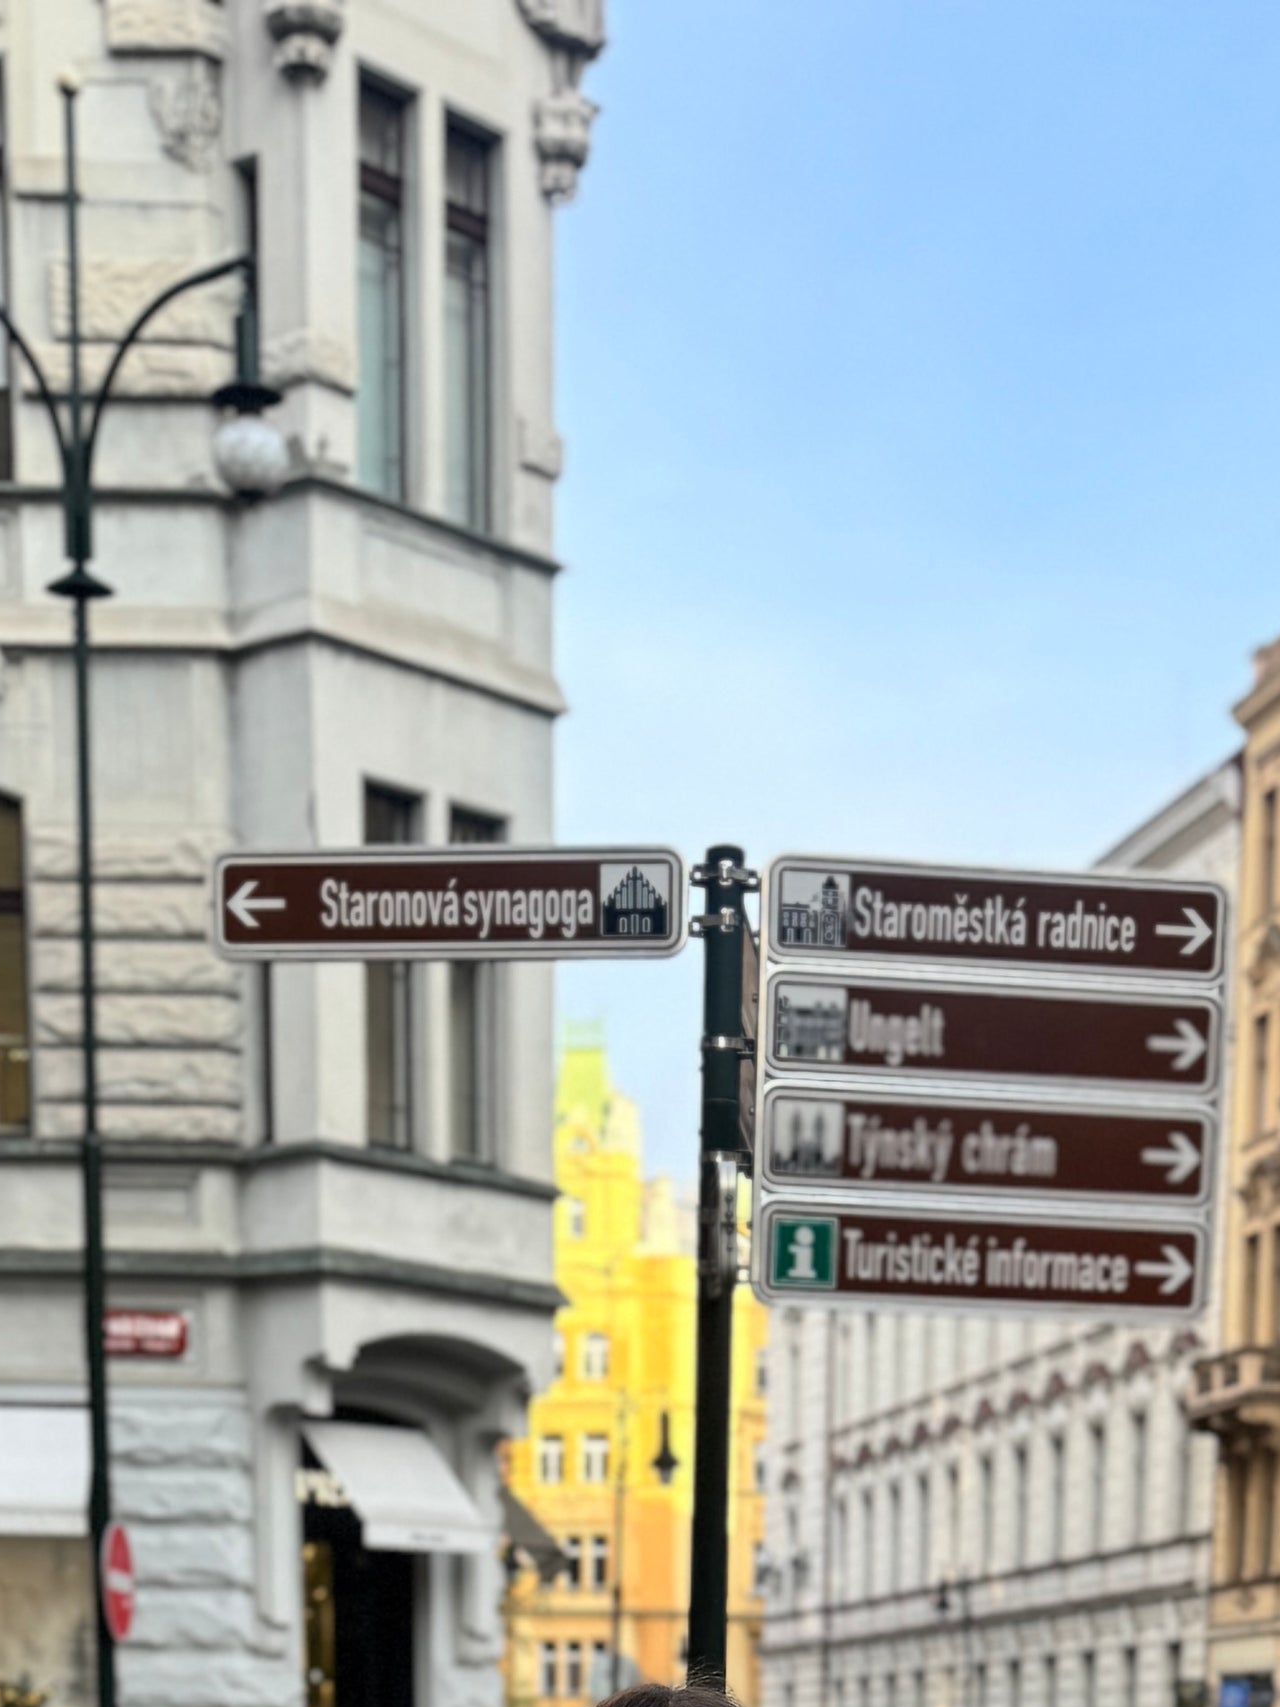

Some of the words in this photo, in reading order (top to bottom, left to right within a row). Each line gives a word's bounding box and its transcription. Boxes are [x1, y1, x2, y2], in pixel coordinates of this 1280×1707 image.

[321, 878, 459, 928] Staronová
[463, 888, 593, 939] synagoga
[1037, 900, 1136, 952] radnice
[961, 1120, 1057, 1177] chrám
[843, 1228, 981, 1285] Turistické
[985, 1236, 1129, 1293] informace
